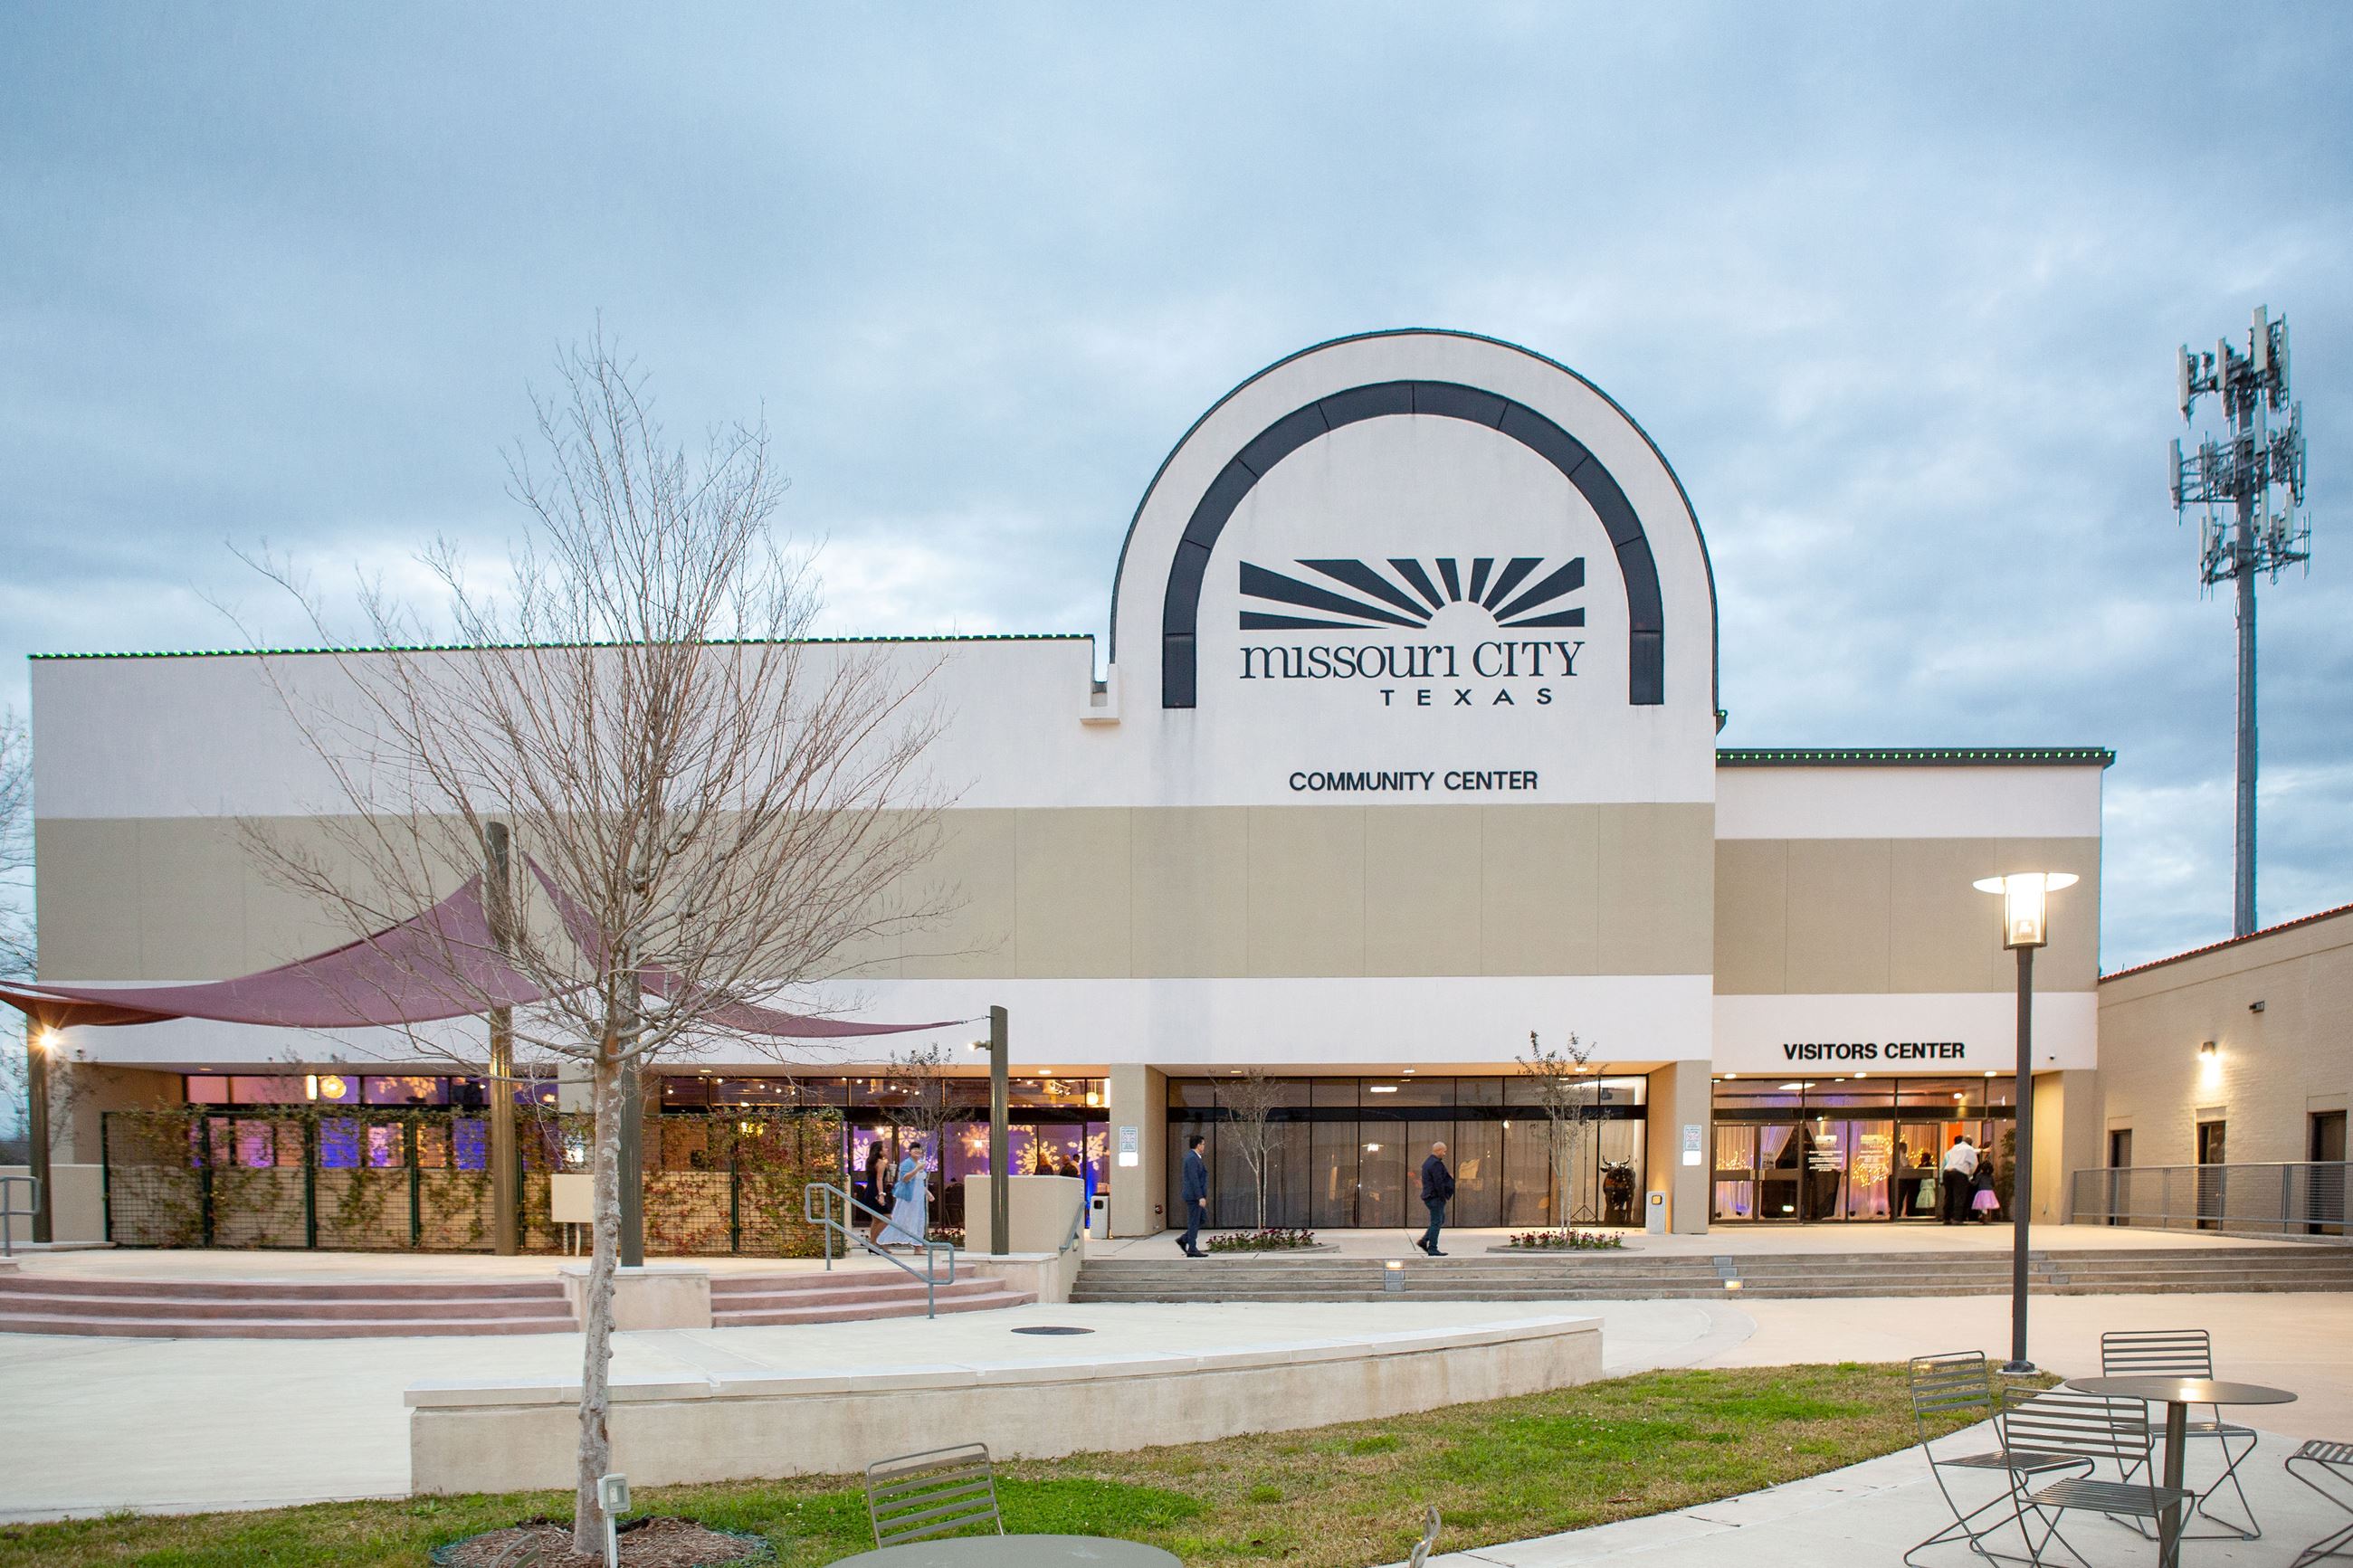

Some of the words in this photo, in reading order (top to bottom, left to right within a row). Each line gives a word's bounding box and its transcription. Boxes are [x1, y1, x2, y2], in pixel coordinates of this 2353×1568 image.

[1472, 641, 1585, 678] CITY
[1380, 688, 1552, 706] TEXAS
[1289, 771, 1434, 792] COMMUNITY
[1443, 771, 1538, 790] CENTER
[1784, 1042, 1878, 1060] VISITORS
[1884, 1042, 1965, 1060] CENTER
